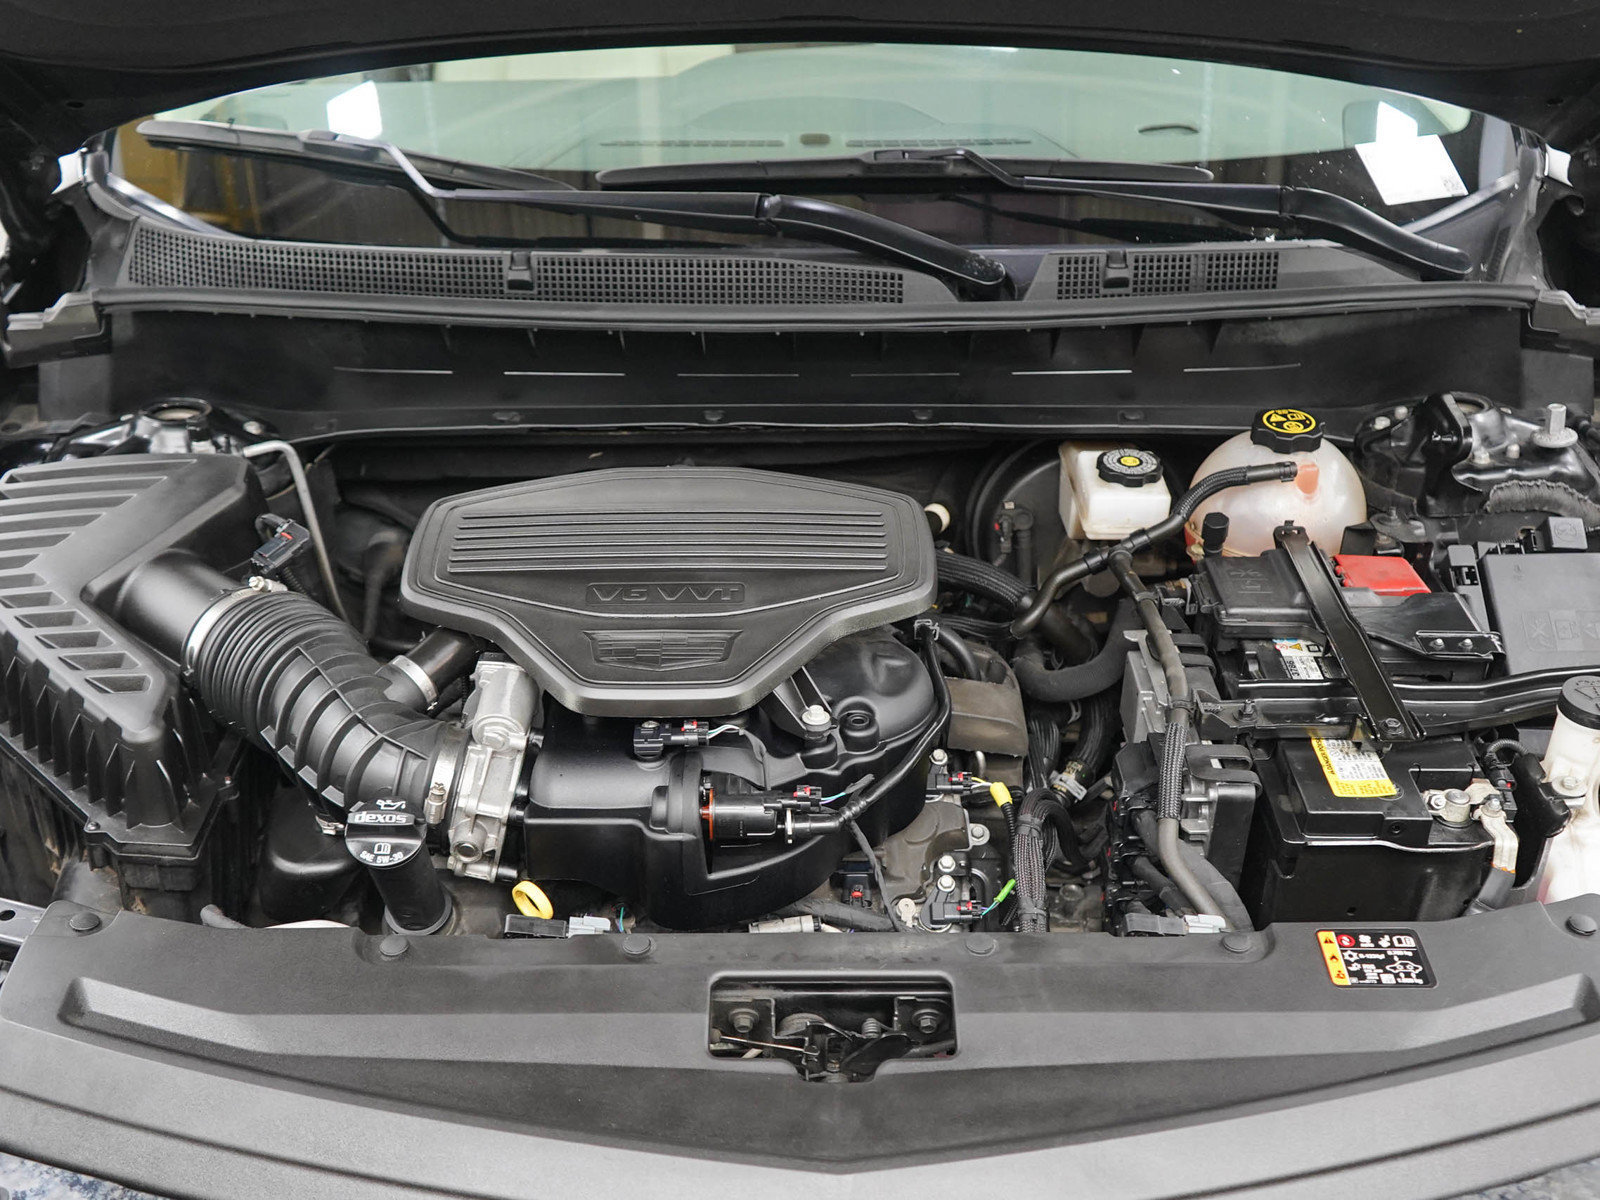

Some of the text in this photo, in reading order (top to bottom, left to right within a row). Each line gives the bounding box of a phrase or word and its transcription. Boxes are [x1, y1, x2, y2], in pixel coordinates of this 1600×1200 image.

[593, 586, 740, 602] V6 VVT
[354, 811, 407, 824] dexos
[360, 850, 404, 864] SAE 5W-30
